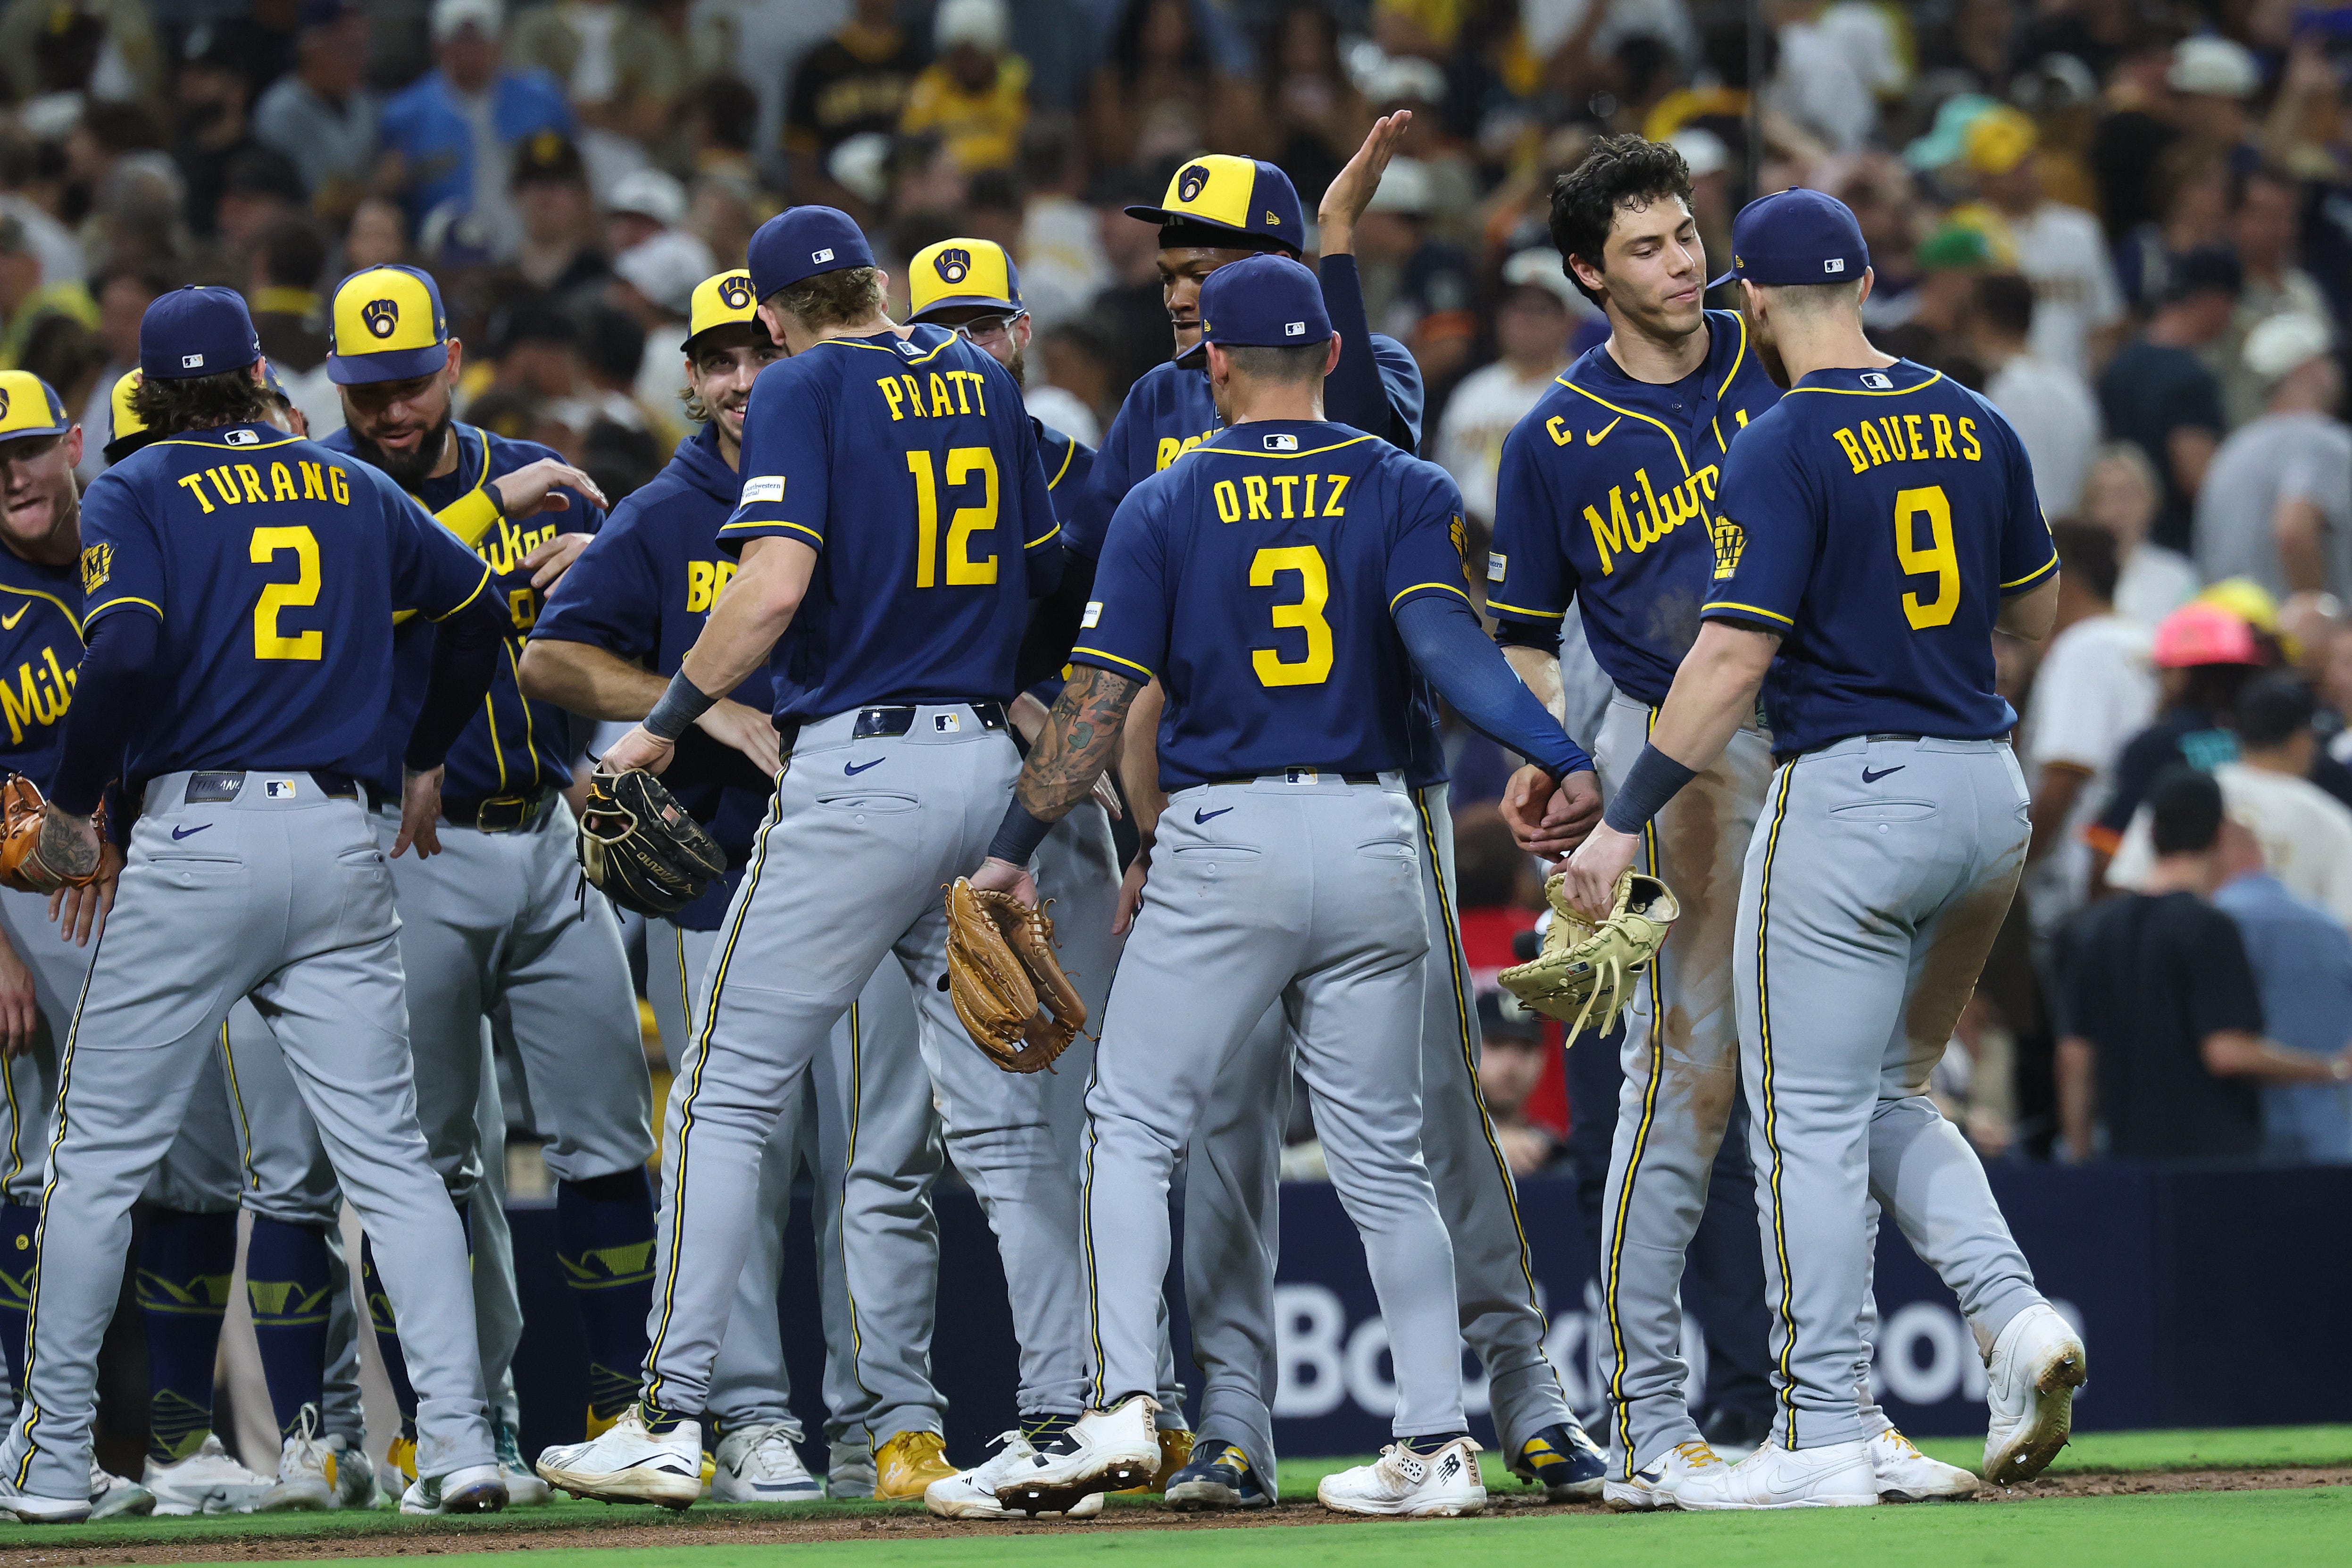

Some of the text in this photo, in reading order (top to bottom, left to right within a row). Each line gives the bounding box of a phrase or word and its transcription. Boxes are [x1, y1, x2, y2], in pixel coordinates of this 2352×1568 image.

[876, 370, 986, 421] PRATT
[1546, 415, 1572, 446] C
[1832, 413, 1982, 475] BAUERS
[178, 460, 350, 514] TURANG
[906, 446, 1000, 588] 12
[1213, 473, 1352, 524] ORTIZ
[1893, 484, 1960, 631] 9
[249, 525, 323, 661] 2
[1249, 544, 1334, 688] 3
